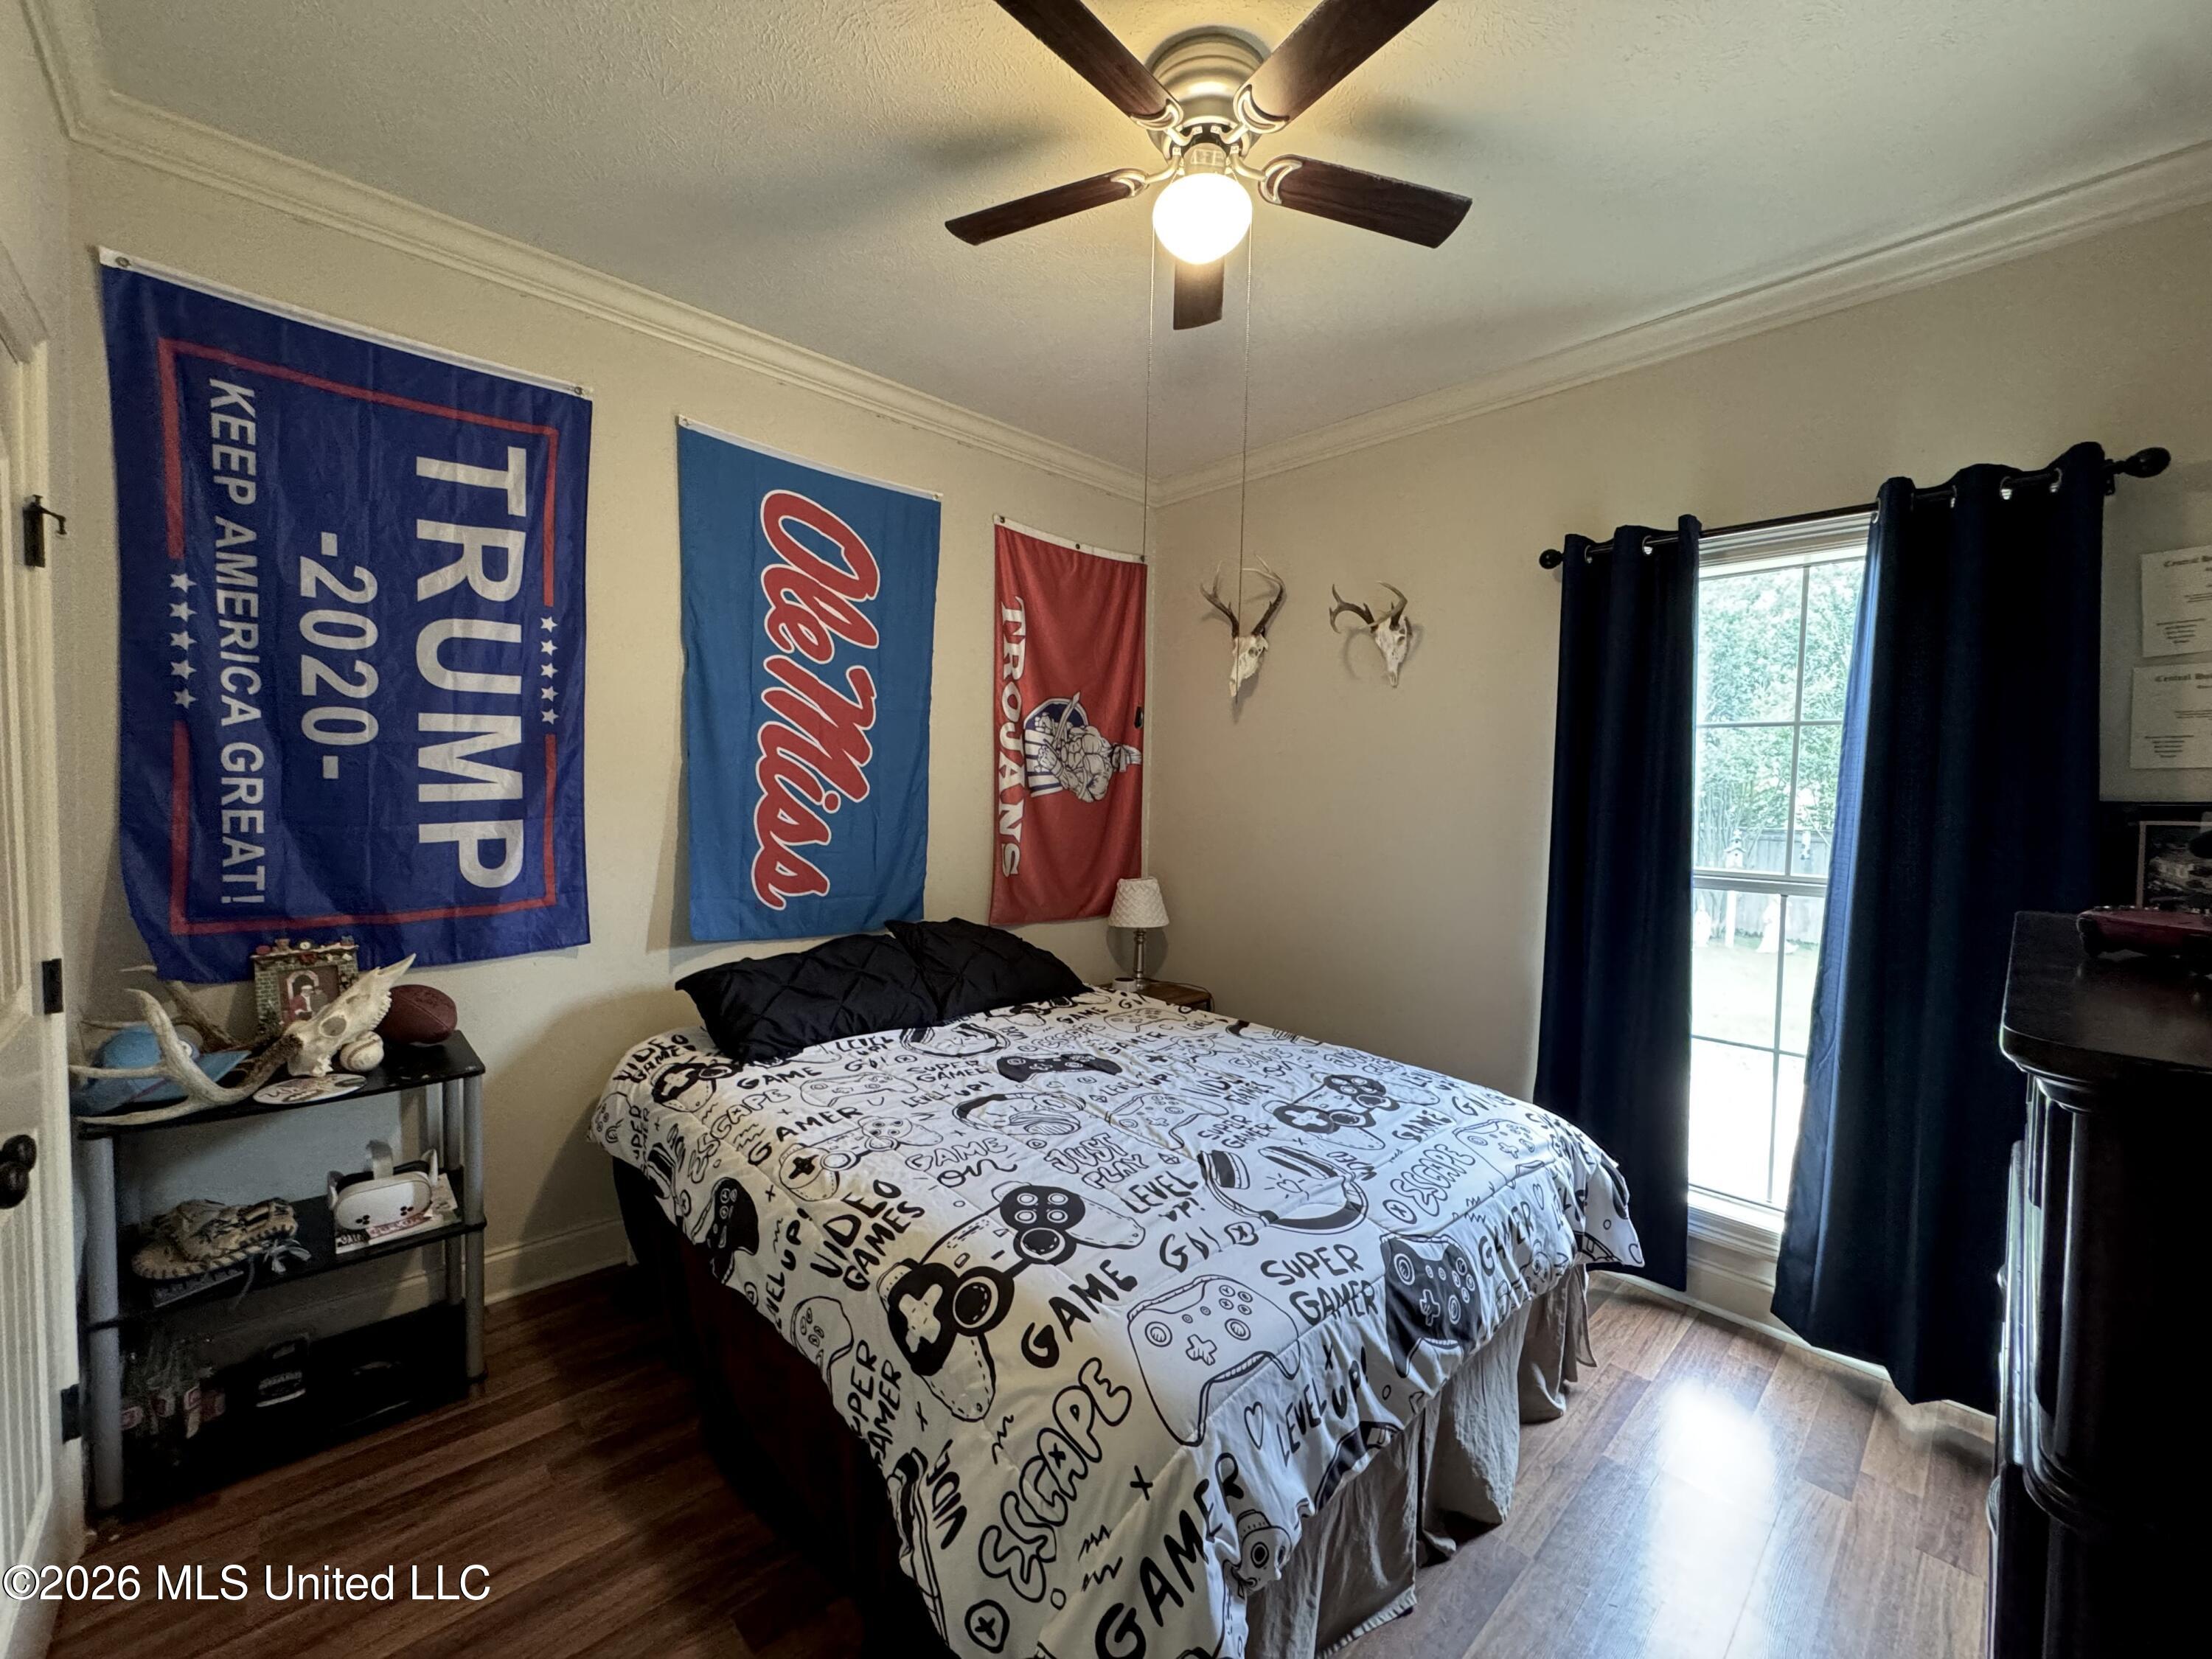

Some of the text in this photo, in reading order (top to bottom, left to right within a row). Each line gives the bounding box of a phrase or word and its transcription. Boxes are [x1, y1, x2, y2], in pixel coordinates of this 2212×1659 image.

[209, 378, 265, 905] KEEP AMERICA GREAT!
[415, 447, 526, 888] TRUMP
[751, 489, 880, 911] Ole Miss
[999, 595, 1026, 878] TROJANS
[1057, 1006, 1108, 1024] GAME
[613, 1034, 689, 1081] VIDEO
[737, 1067, 822, 1089] GAME
[907, 1060, 981, 1074] SUPER
[916, 1068, 991, 1082] GAMER
[901, 1090, 951, 1107] LEVEL
[748, 1106, 863, 1166] GAMER
[1197, 1115, 1252, 1140] SUPER
[1221, 1123, 1277, 1148] GAMER
[905, 1138, 1008, 1172] GAME
[1044, 1133, 1128, 1174] JUST
[1082, 1154, 1150, 1189] PLAY
[1121, 1171, 1199, 1213] LEVEL
[810, 1180, 902, 1278] VIDEO
[843, 1201, 925, 1292] GAMES
[1261, 1244, 1364, 1286] SUPER
[1021, 1259, 1138, 1368] GAME
[1289, 1279, 1379, 1326] GAMER
[847, 1339, 877, 1436] UPER
[1276, 1346, 1370, 1467] LEVEL UP!
[978, 1357, 1132, 1602] ESCAPE
[1095, 1453, 1244, 1659] GAMER
